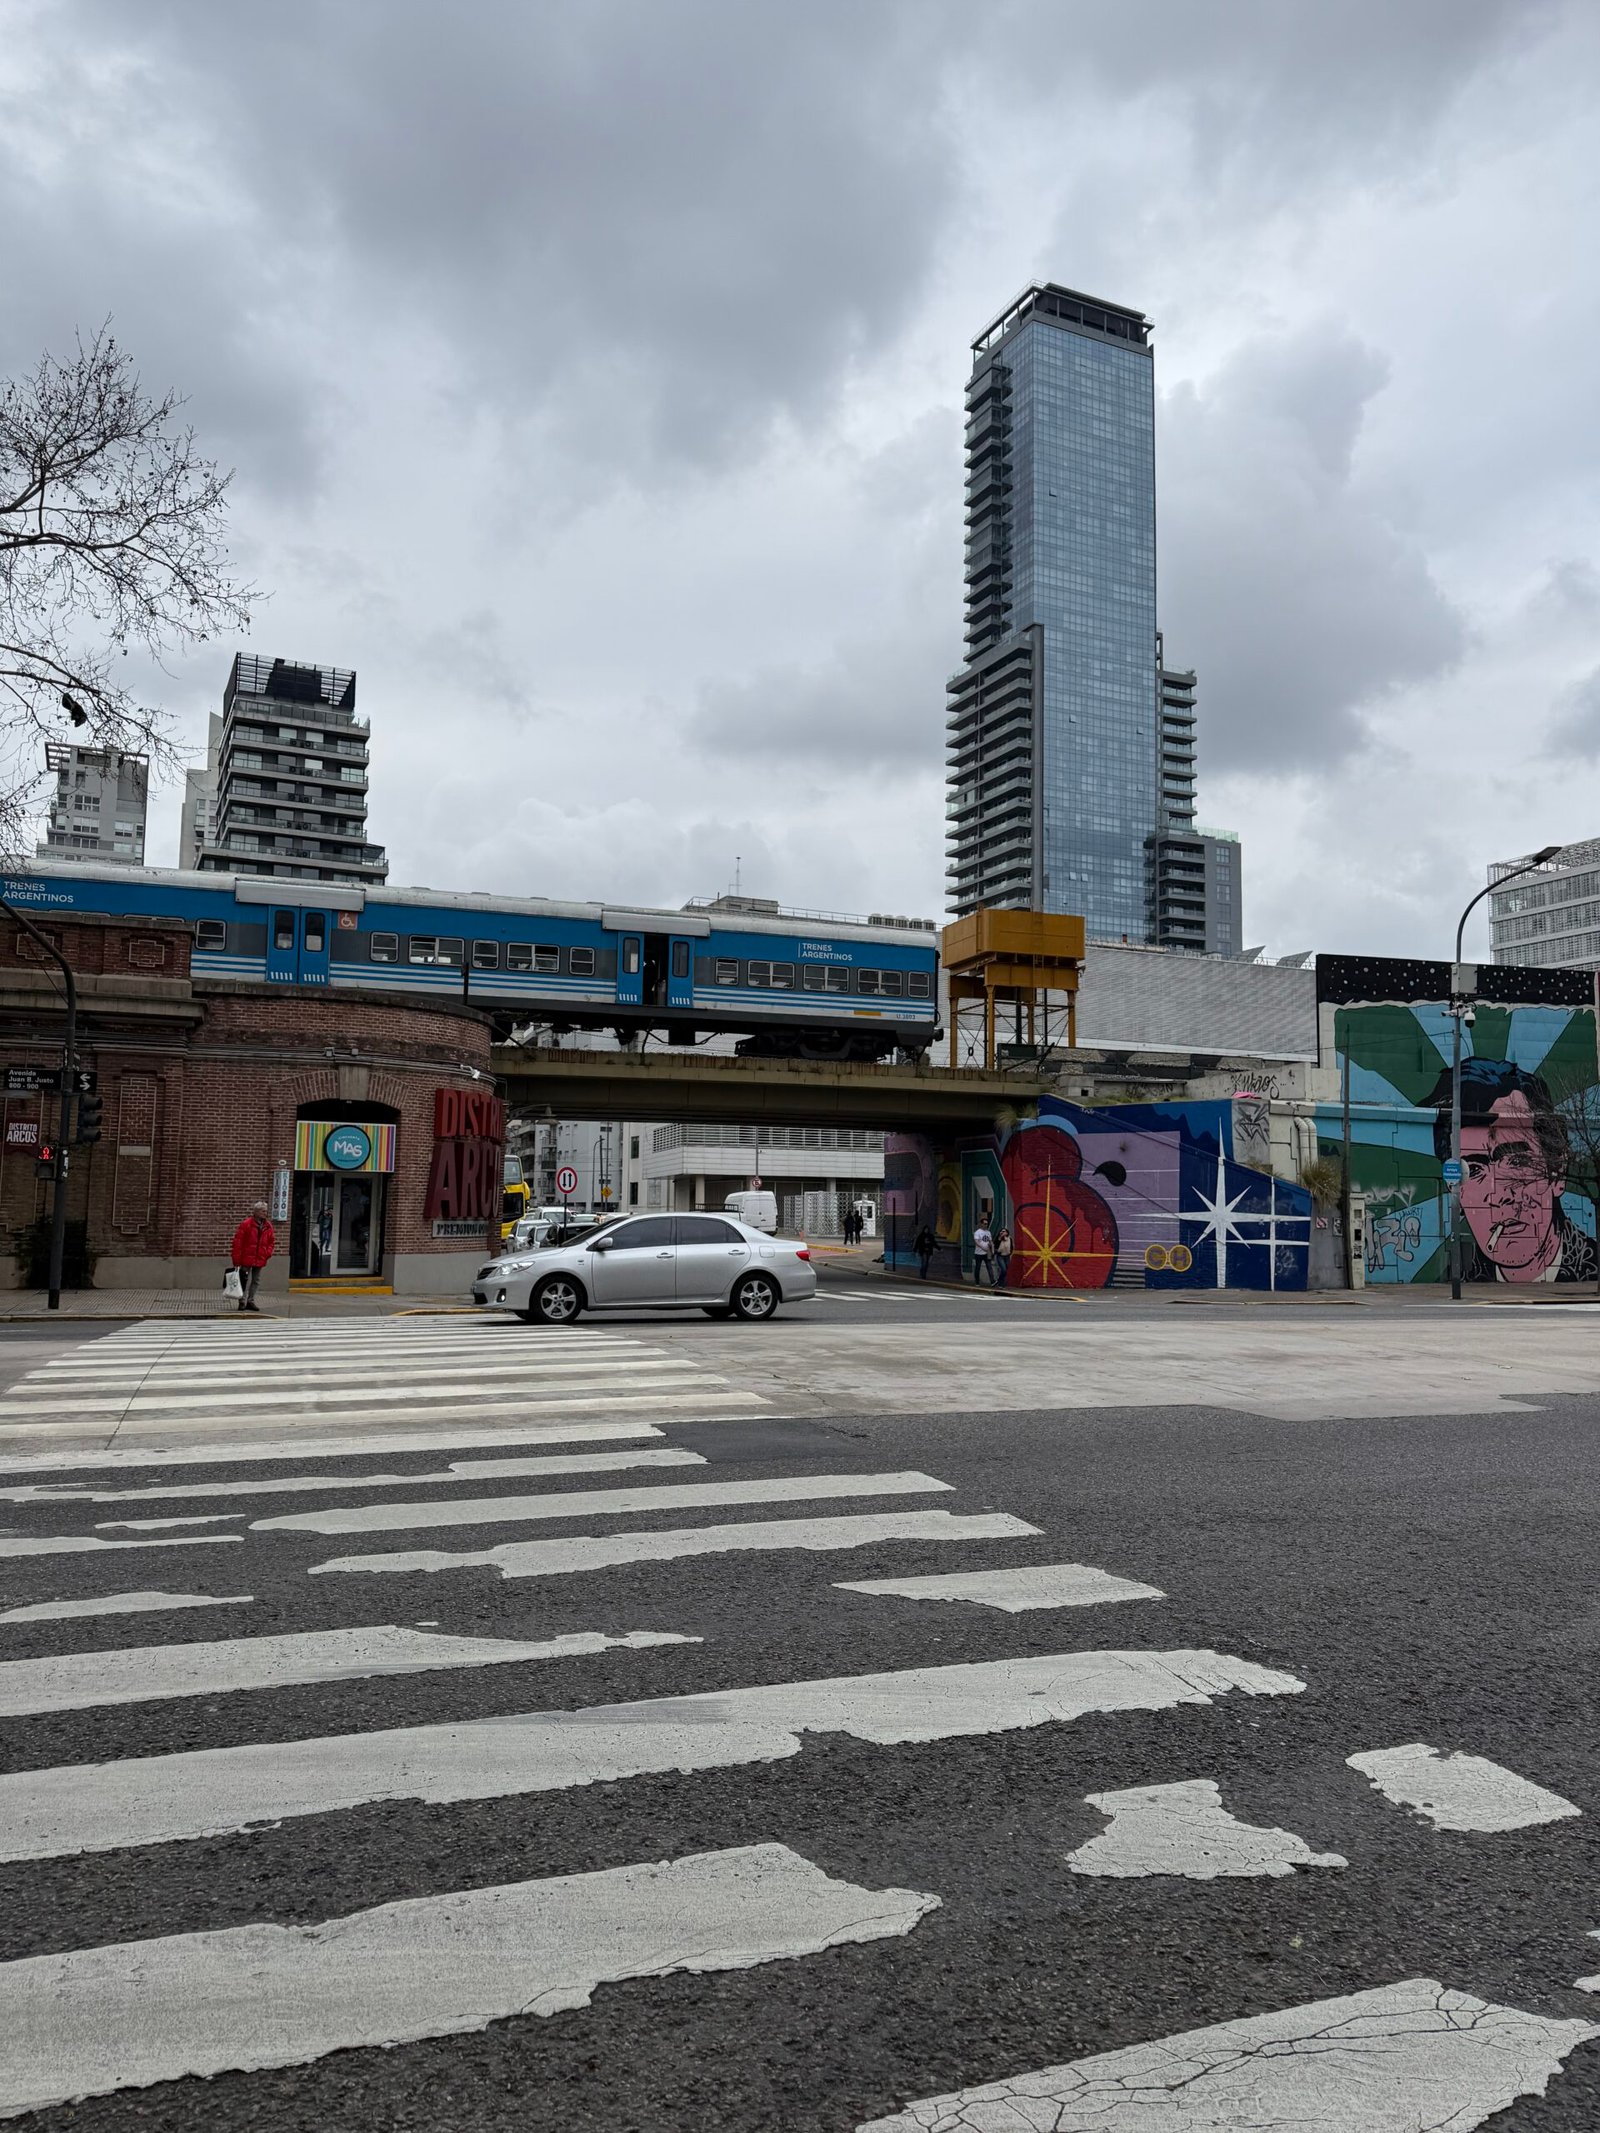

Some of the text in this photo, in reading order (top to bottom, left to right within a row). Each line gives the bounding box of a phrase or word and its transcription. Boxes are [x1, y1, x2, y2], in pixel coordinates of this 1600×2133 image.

[4, 881, 46, 892] TRENES
[2, 890, 74, 903] ARGENTINOS
[802, 943, 833, 952] TRENES
[801, 951, 853, 961] ARGENTINOS
[9, 1122, 38, 1132] DISTRITO
[6, 1130, 38, 1143] ARCOS
[334, 1140, 363, 1157] MAS
[430, 1141, 502, 1218] ARCO
